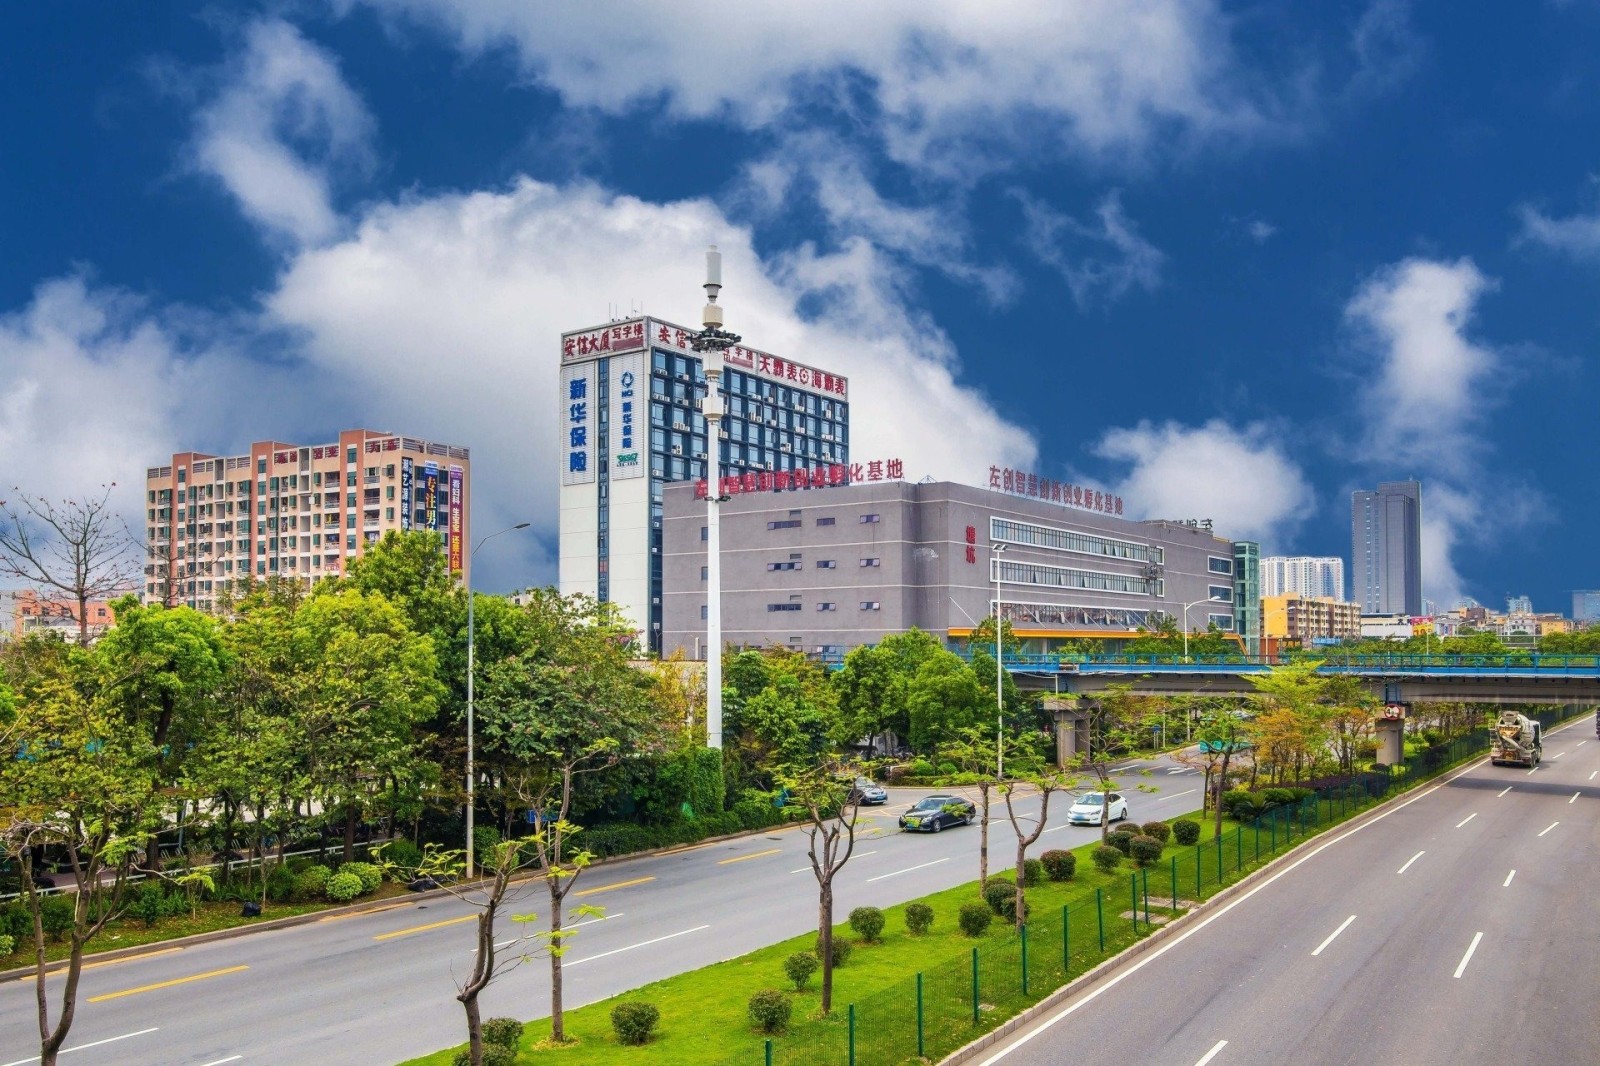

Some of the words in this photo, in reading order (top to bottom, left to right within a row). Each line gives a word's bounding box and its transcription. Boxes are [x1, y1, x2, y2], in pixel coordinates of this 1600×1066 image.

[564, 330, 611, 356] 安信大厦
[569, 378, 587, 472] 新华保险
[695, 457, 904, 498] 左智慧创新创业孵化基地
[425, 475, 437, 531] 专注男
